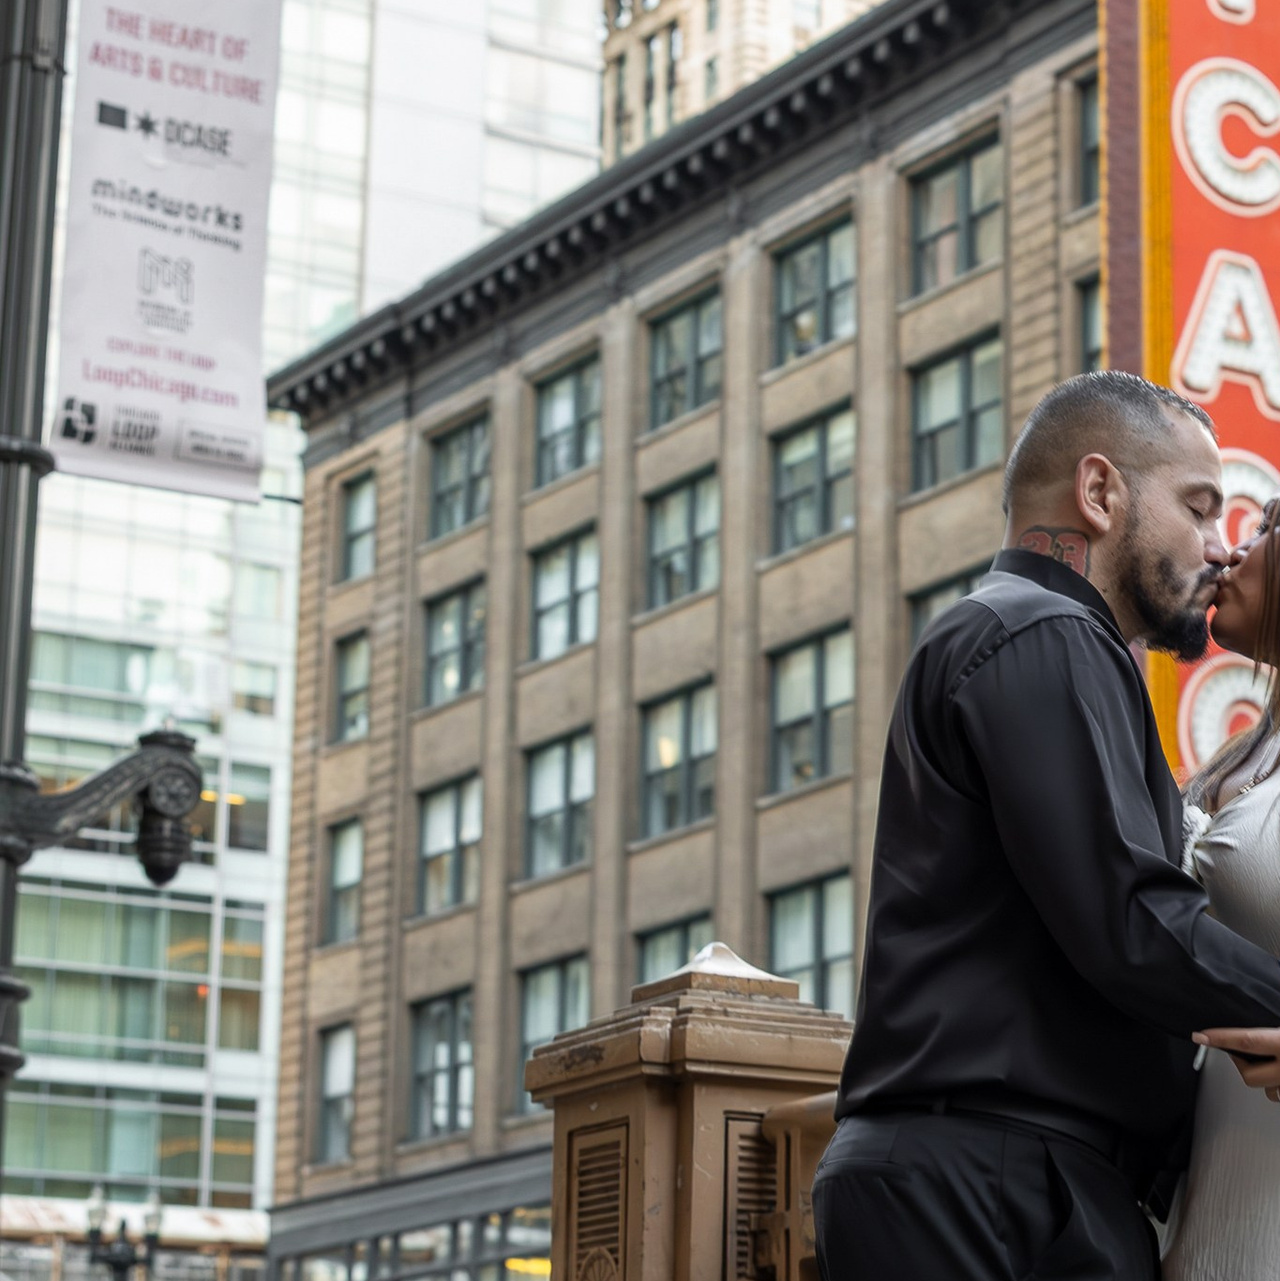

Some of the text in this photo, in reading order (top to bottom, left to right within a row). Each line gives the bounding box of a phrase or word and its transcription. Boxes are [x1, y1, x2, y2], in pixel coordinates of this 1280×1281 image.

[105, 7, 141, 39] THE
[148, 21, 216, 56] HEART
[91, 178, 244, 232] mindworks
